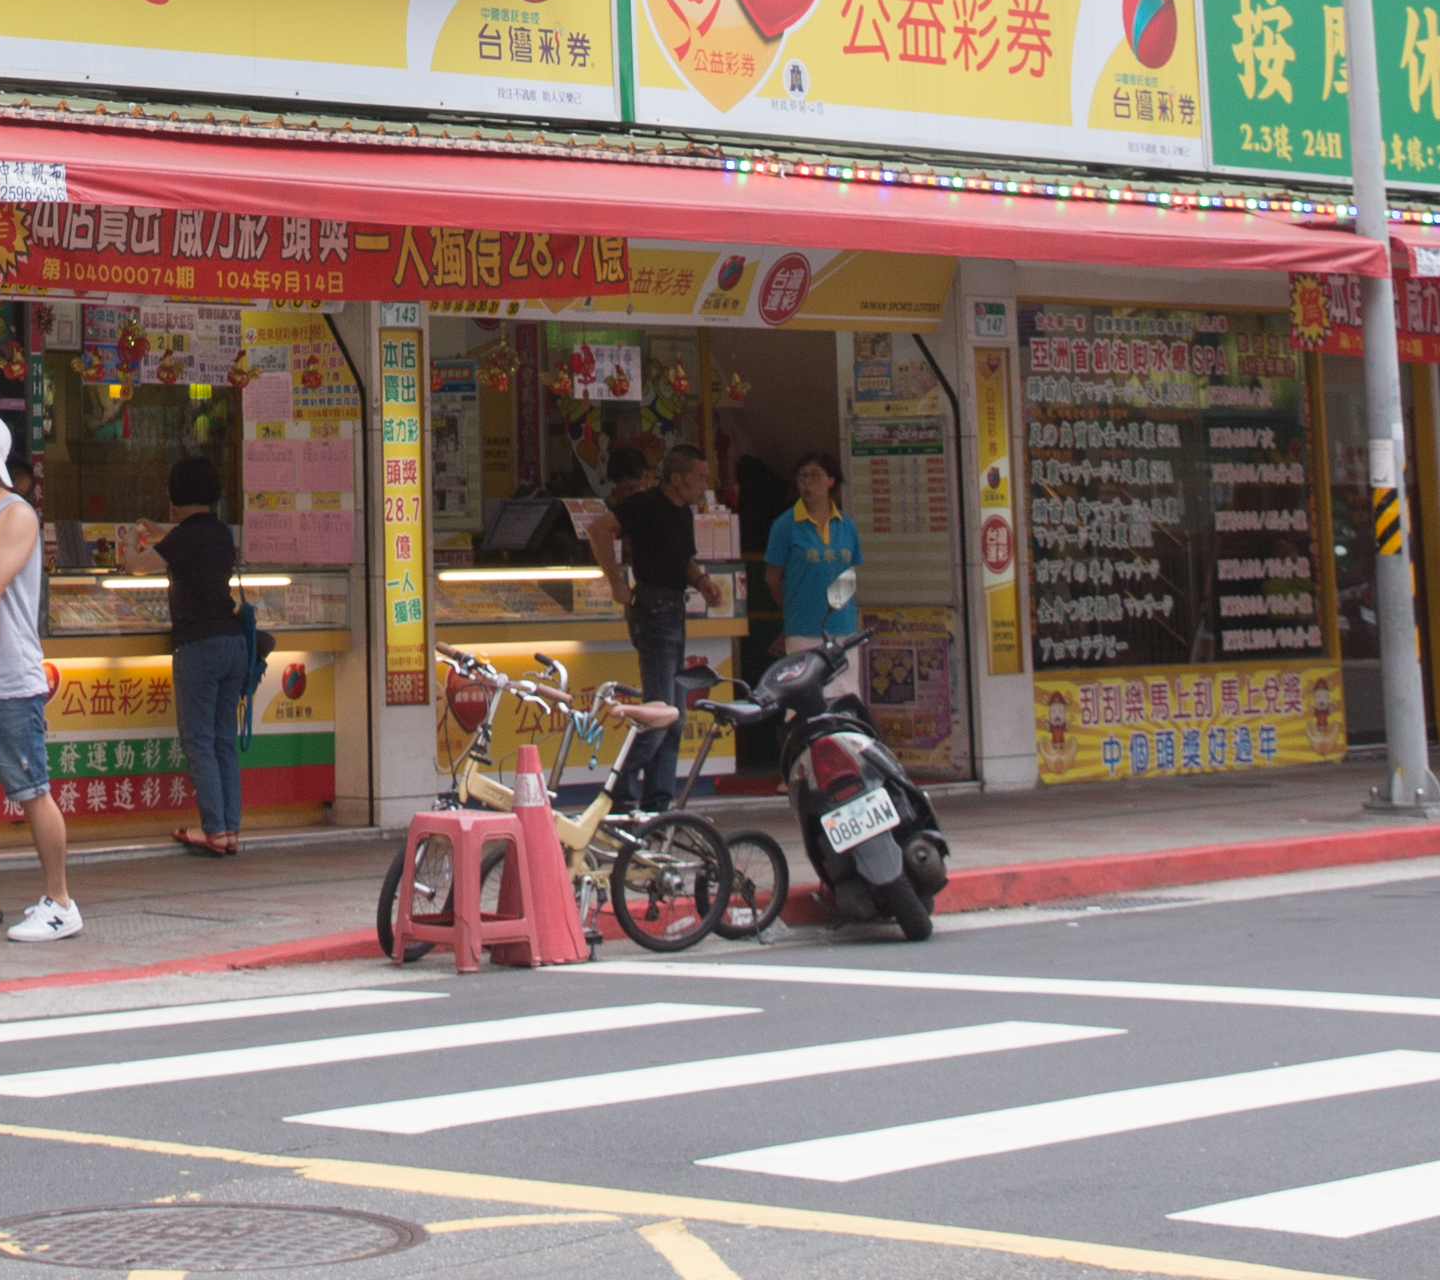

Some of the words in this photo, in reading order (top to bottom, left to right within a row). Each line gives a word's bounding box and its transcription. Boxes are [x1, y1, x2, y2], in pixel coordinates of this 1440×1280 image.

[477, 22, 592, 70] 台灣彩券
[693, 50, 756, 79] 公益彩券
[1112, 87, 1195, 126] 台灣彩券
[43, 256, 195, 291] 第104000074期
[216, 268, 345, 295] 104年9月14日
[395, 306, 417, 324] 143
[383, 418, 419, 443] 威力彩
[385, 497, 421, 523] 28.7
[386, 571, 414, 593] 一人
[1079, 677, 1214, 725] 刮刮樂馬上刮
[1101, 724, 1278, 773] 中個頭獎好過年
[827, 797, 897, 848] 088-JAW
